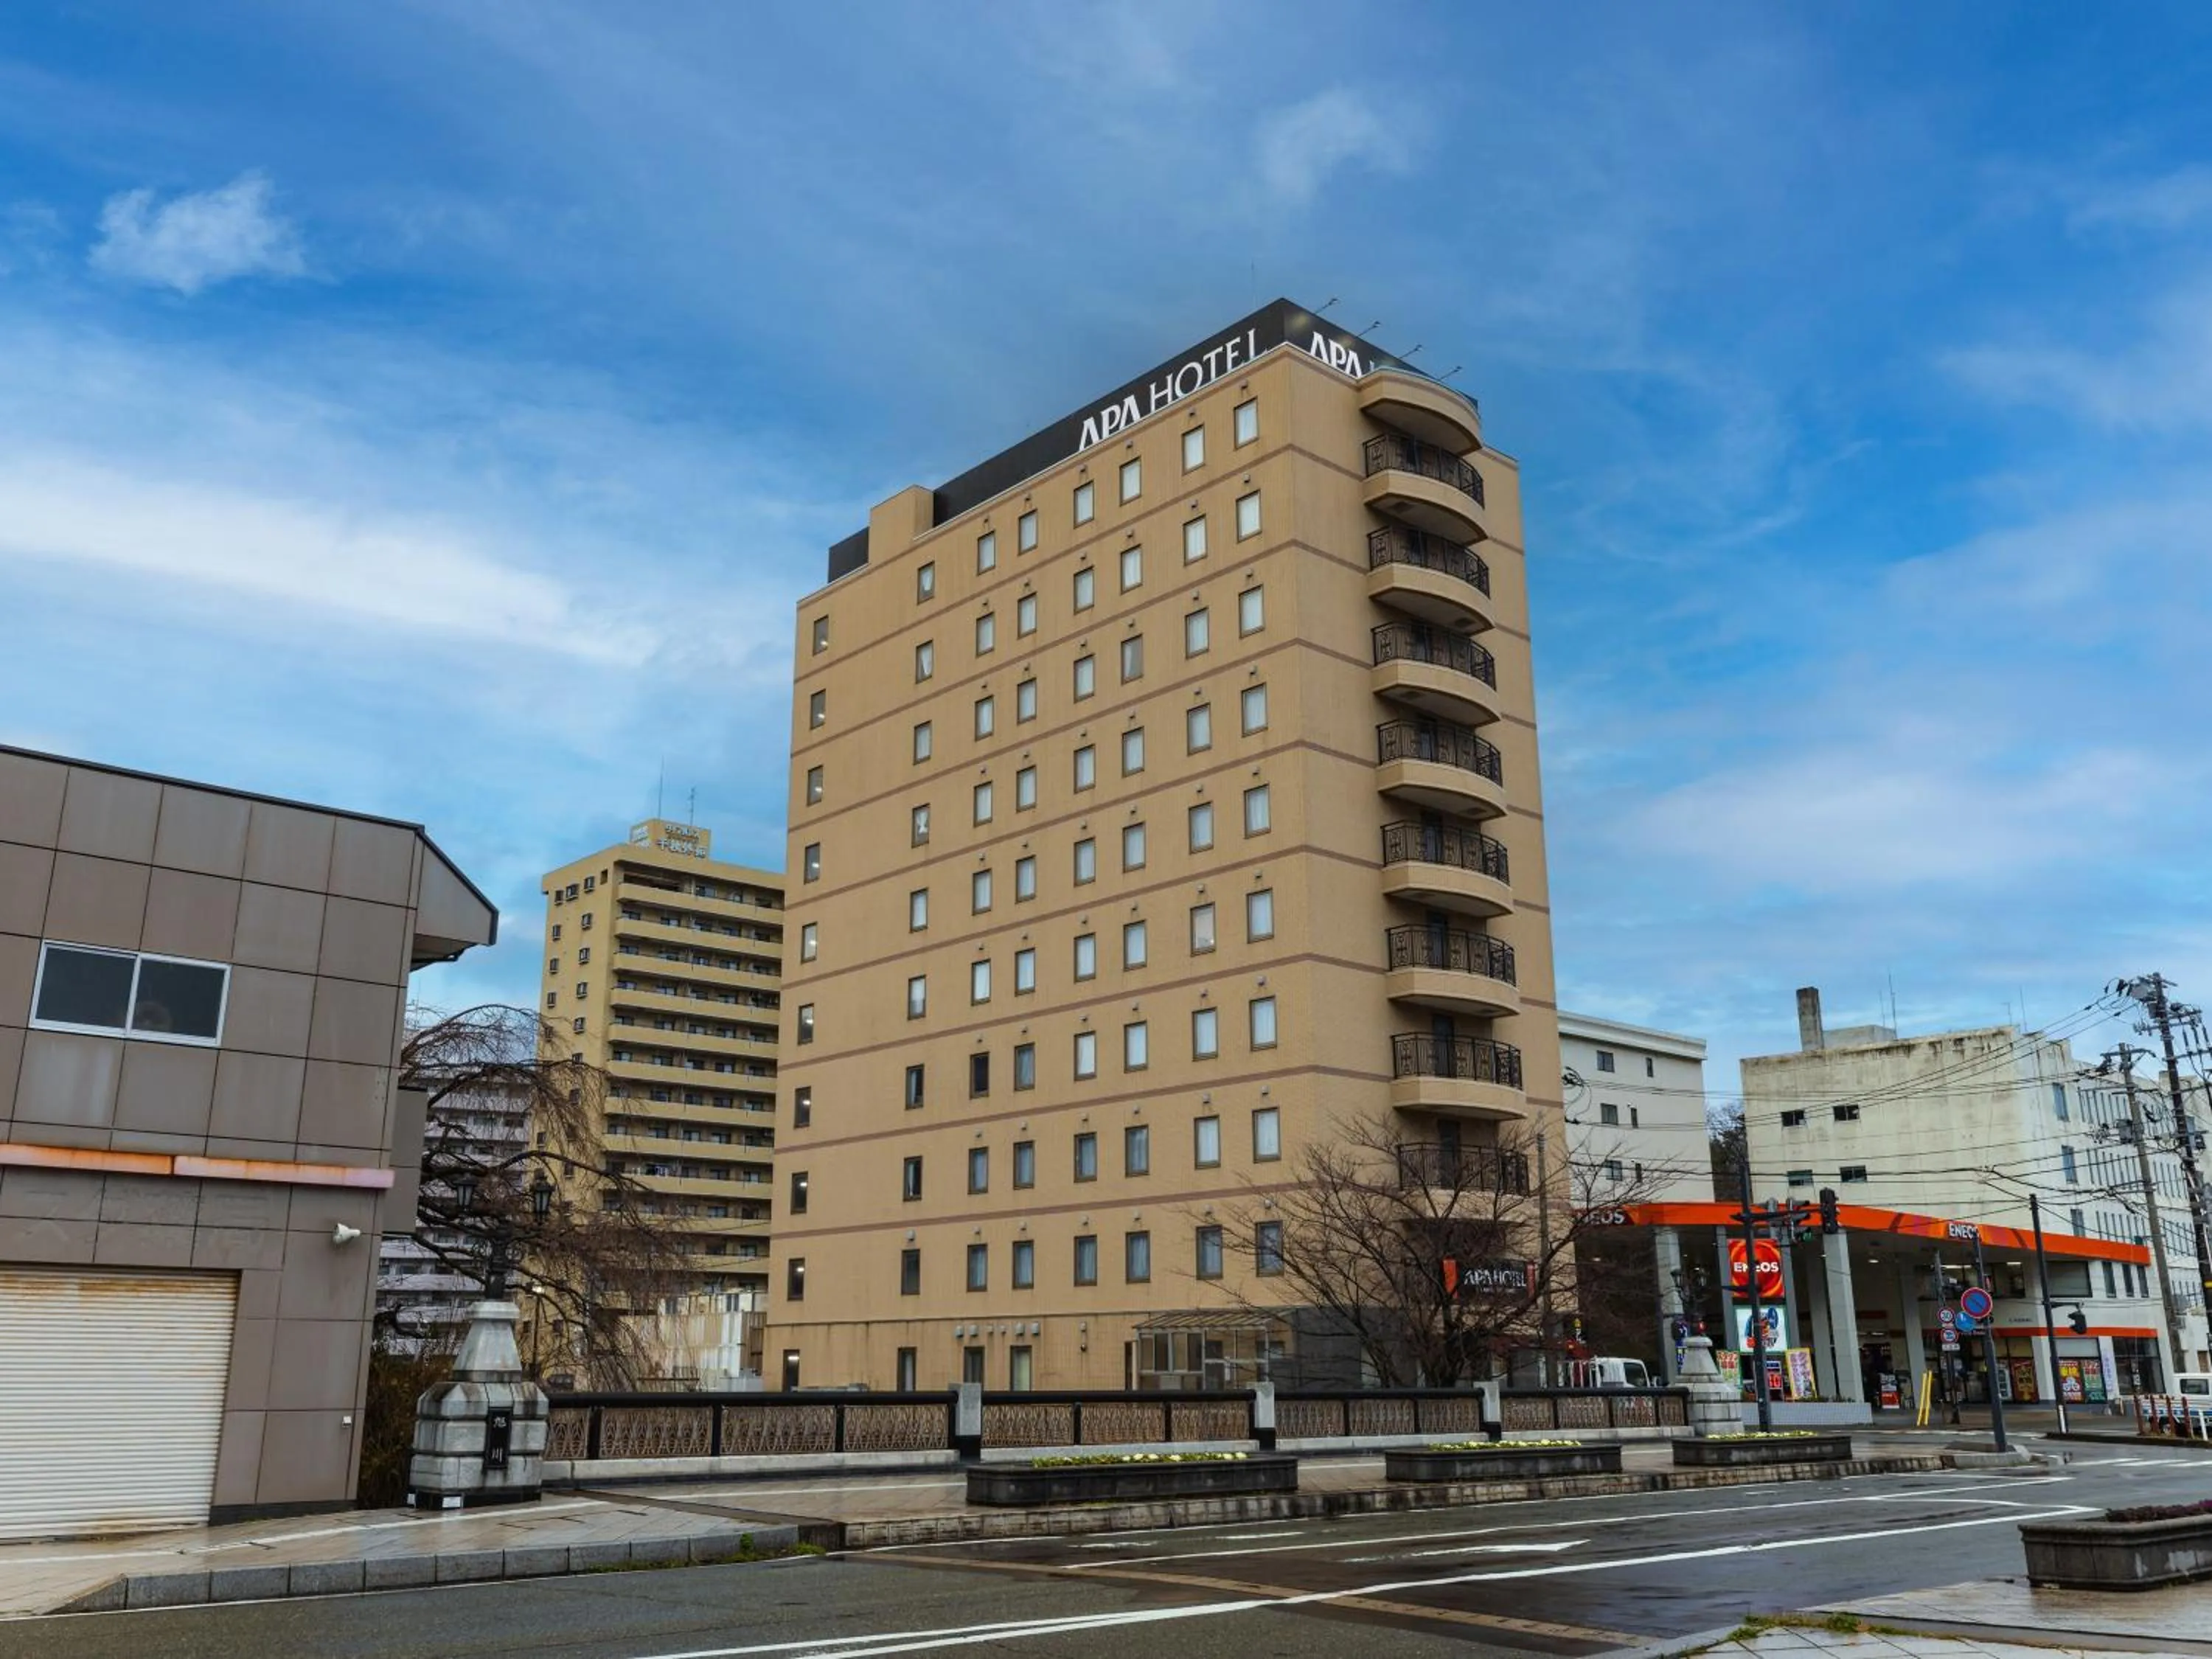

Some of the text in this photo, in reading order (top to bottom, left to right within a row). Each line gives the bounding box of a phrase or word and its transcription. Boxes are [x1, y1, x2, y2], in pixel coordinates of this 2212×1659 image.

[1310, 331, 1363, 378] APA
[1079, 328, 1267, 451] APA HOTEL
[1464, 1269, 1526, 1287] APA HOTEL
[492, 1416, 507, 1464] 旭川
